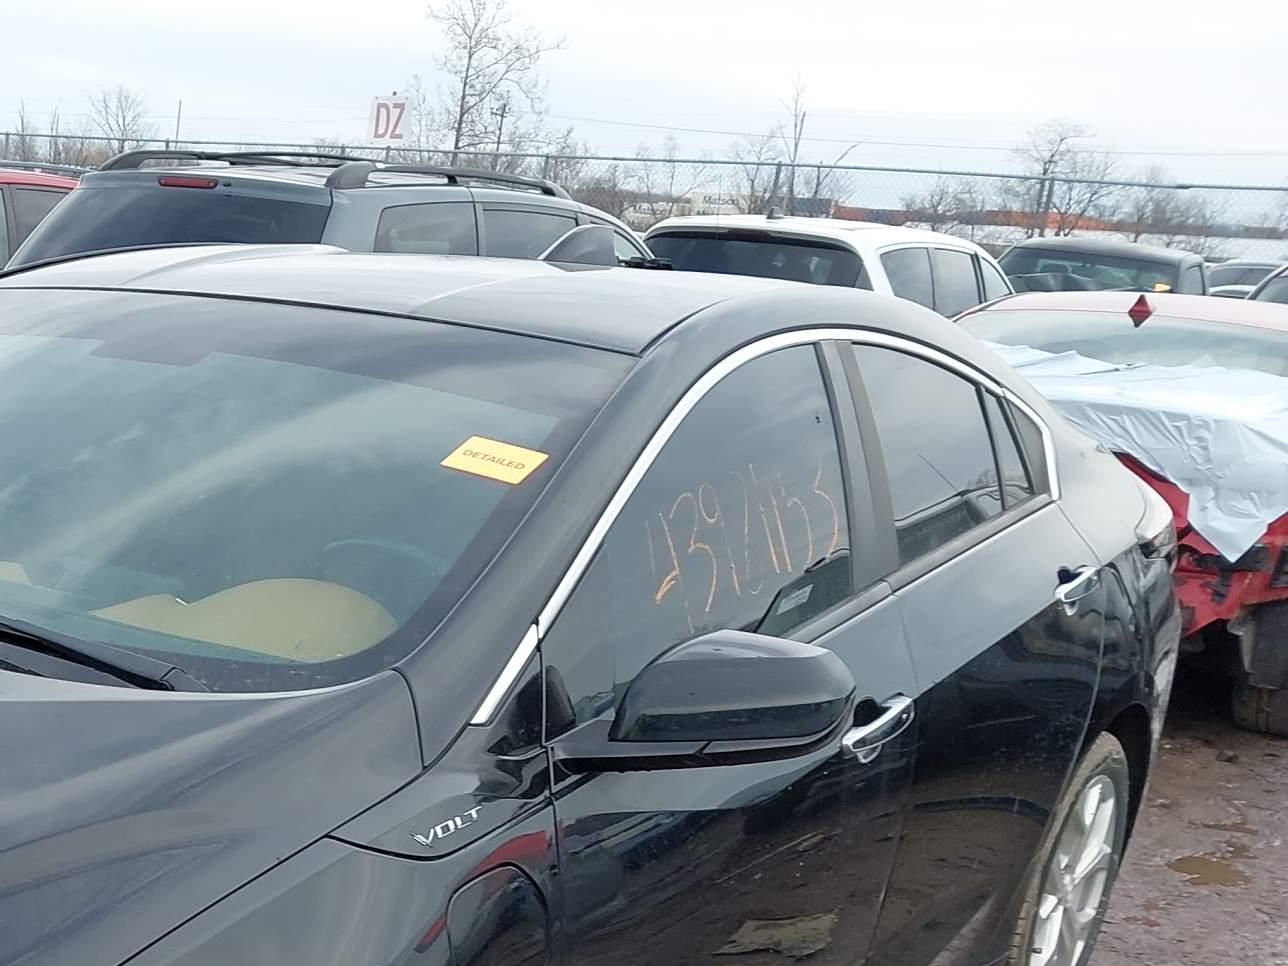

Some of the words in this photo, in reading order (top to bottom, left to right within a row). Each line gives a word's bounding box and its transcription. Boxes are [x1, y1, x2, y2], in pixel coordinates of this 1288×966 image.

[373, 102, 406, 139] DZ
[462, 448, 526, 471] DETAILED
[411, 805, 482, 847] VOLT
